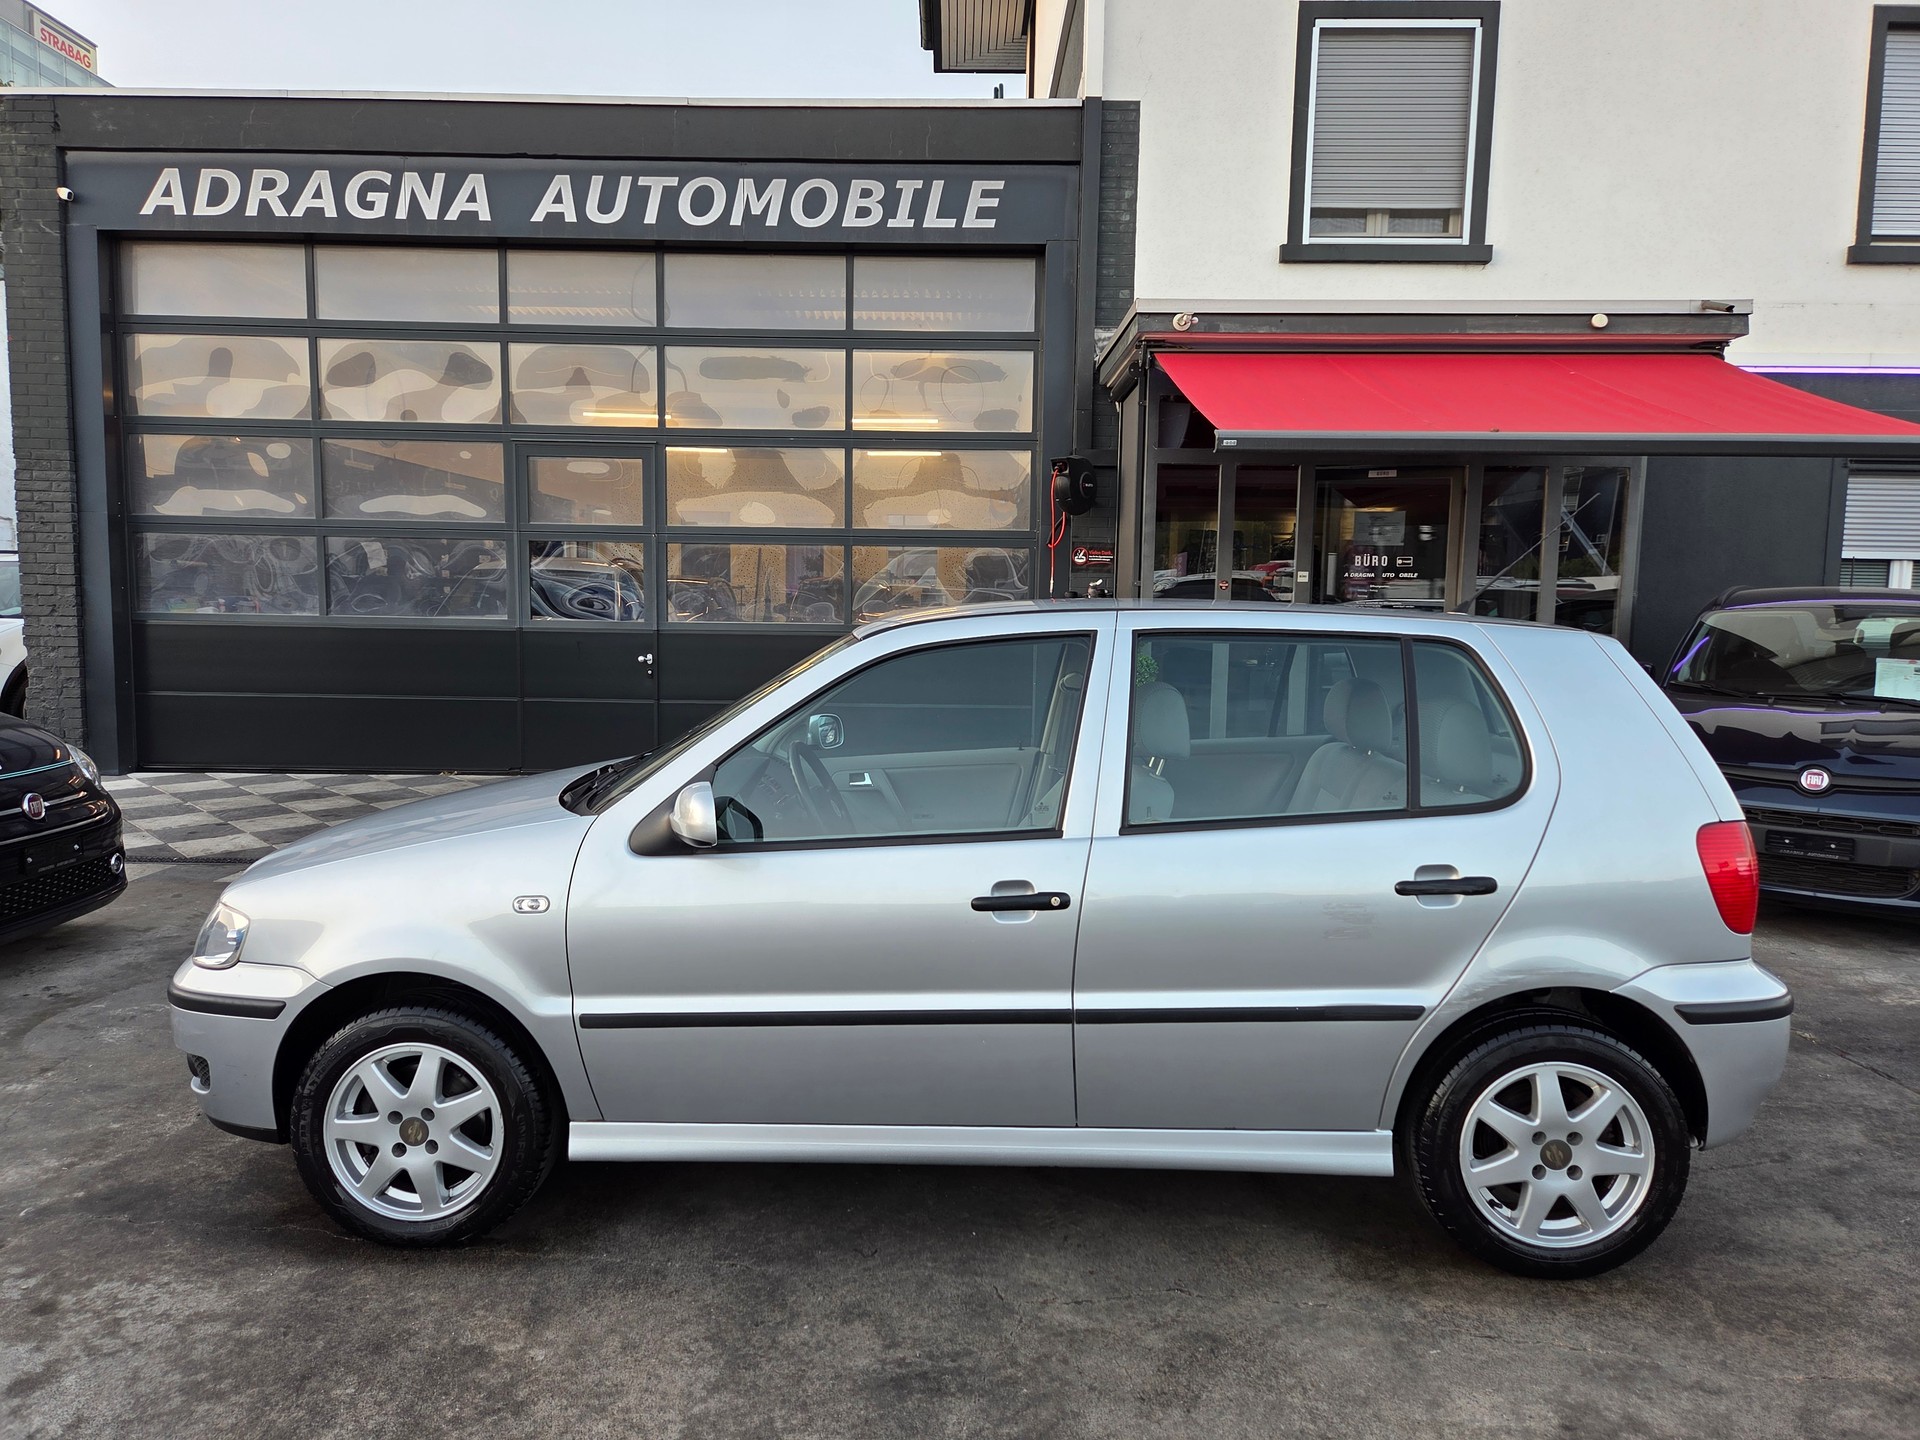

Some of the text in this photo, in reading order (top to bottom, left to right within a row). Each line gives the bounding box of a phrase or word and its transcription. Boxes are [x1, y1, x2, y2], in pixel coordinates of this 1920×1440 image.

[40, 27, 91, 68] STRABAG
[139, 168, 1005, 228] ADRAGNA AUTOMOBILE
[1354, 553, 1388, 567] BÜRO
[1806, 774, 1823, 785] FIAT
